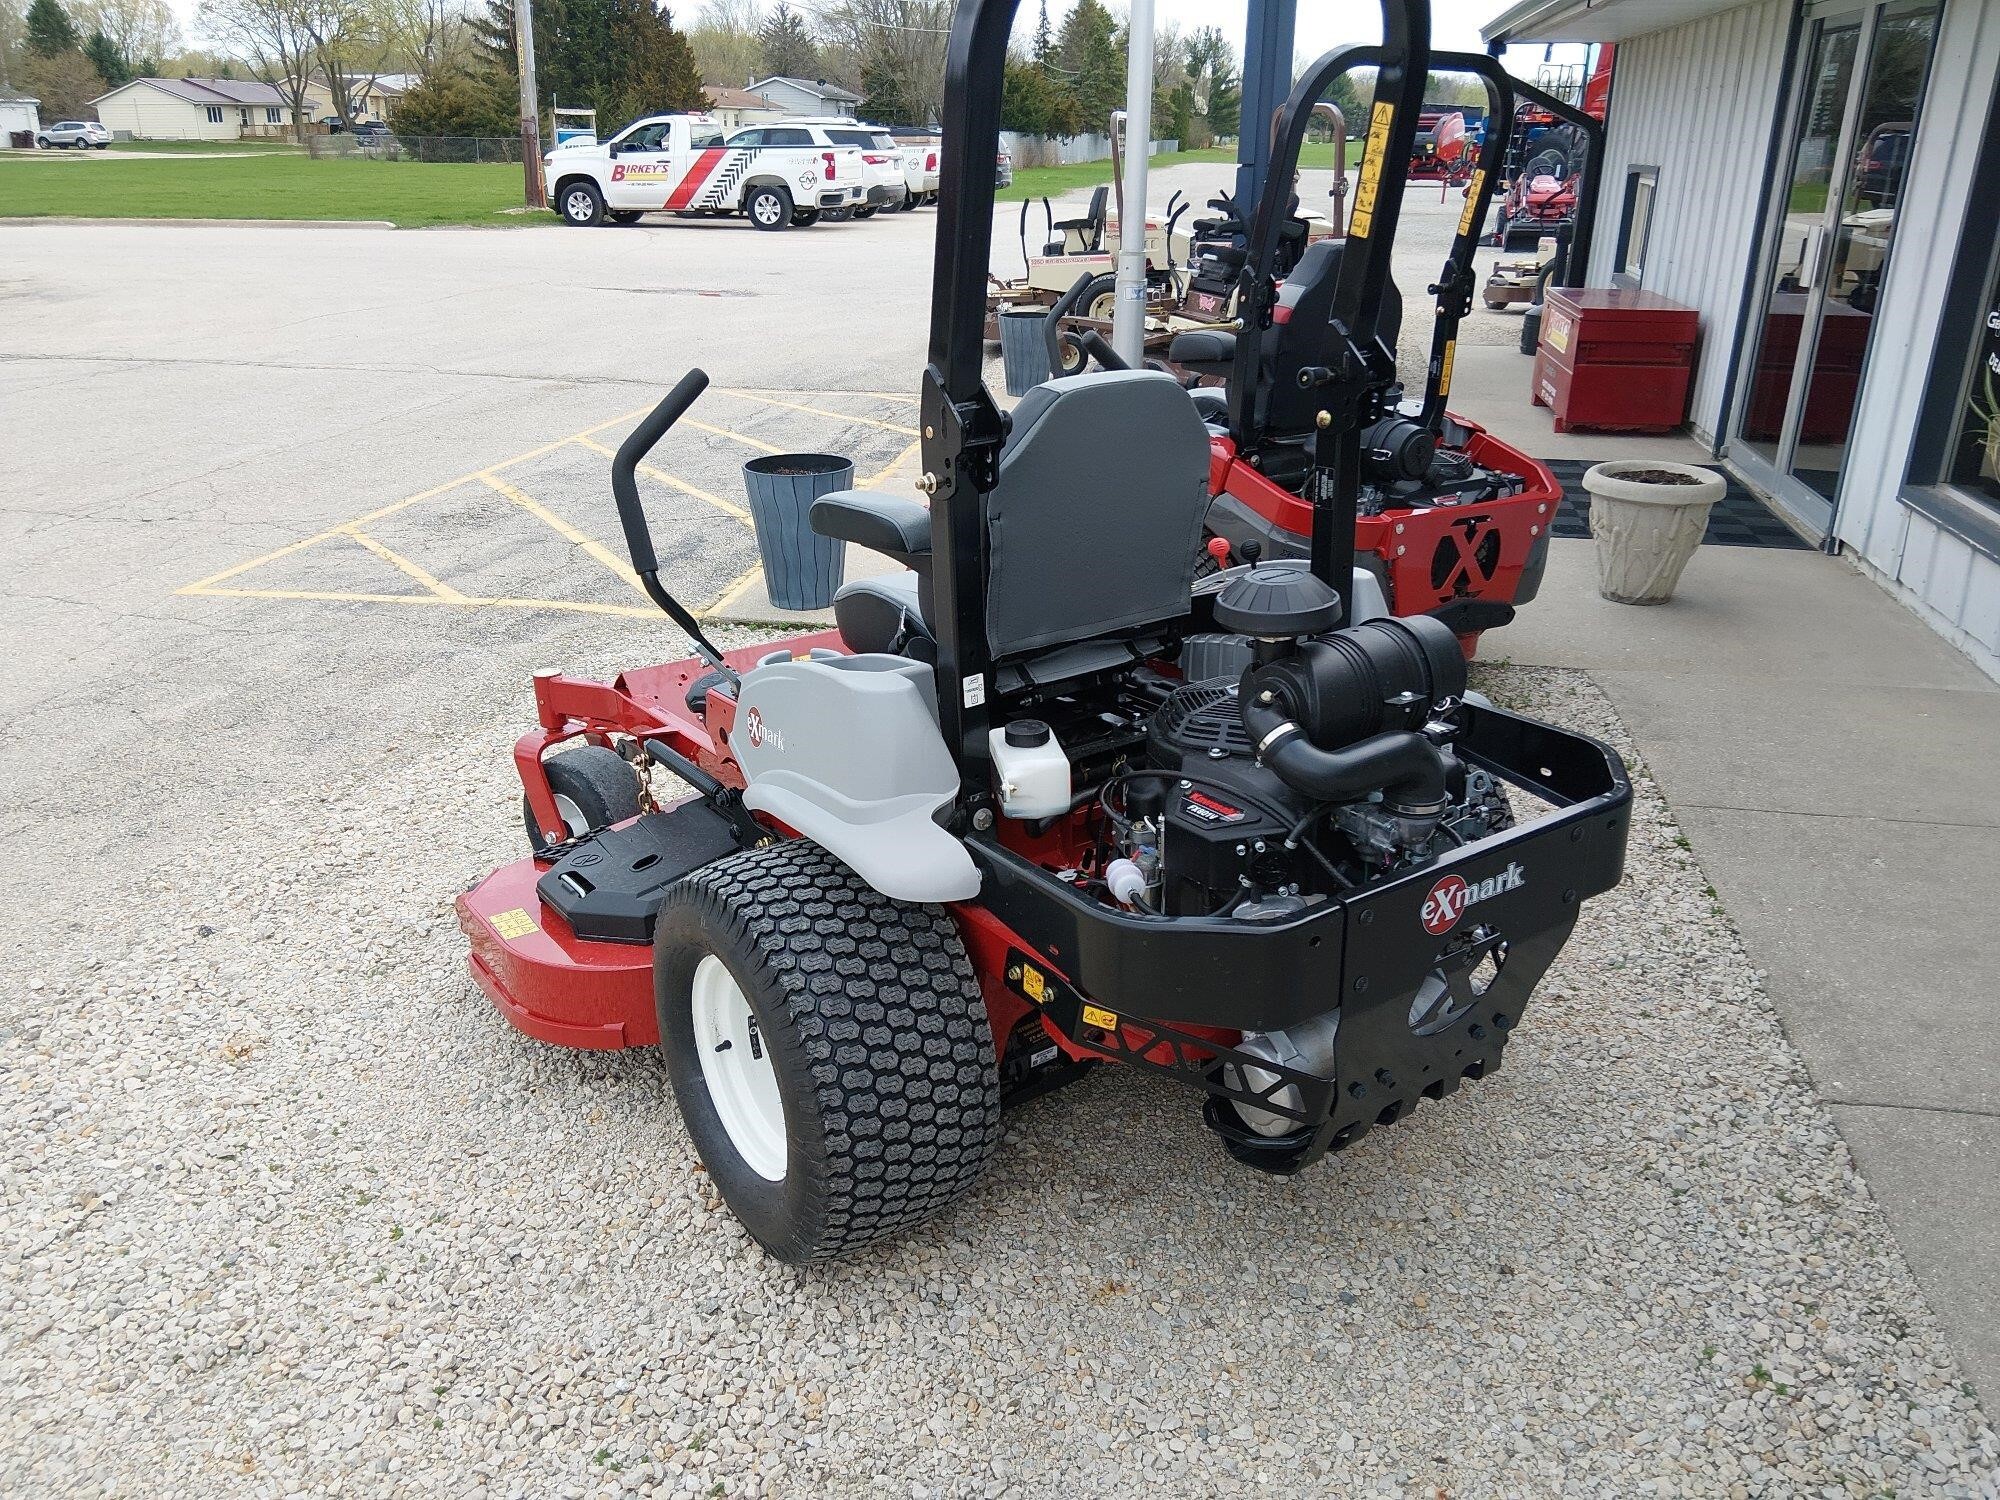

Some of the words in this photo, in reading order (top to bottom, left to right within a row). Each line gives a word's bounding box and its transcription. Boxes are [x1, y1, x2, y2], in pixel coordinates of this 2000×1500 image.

[611, 164, 669, 182] BIRKEY'S
[747, 712, 784, 751] eXmark
[1421, 861, 1525, 927] eXmark
